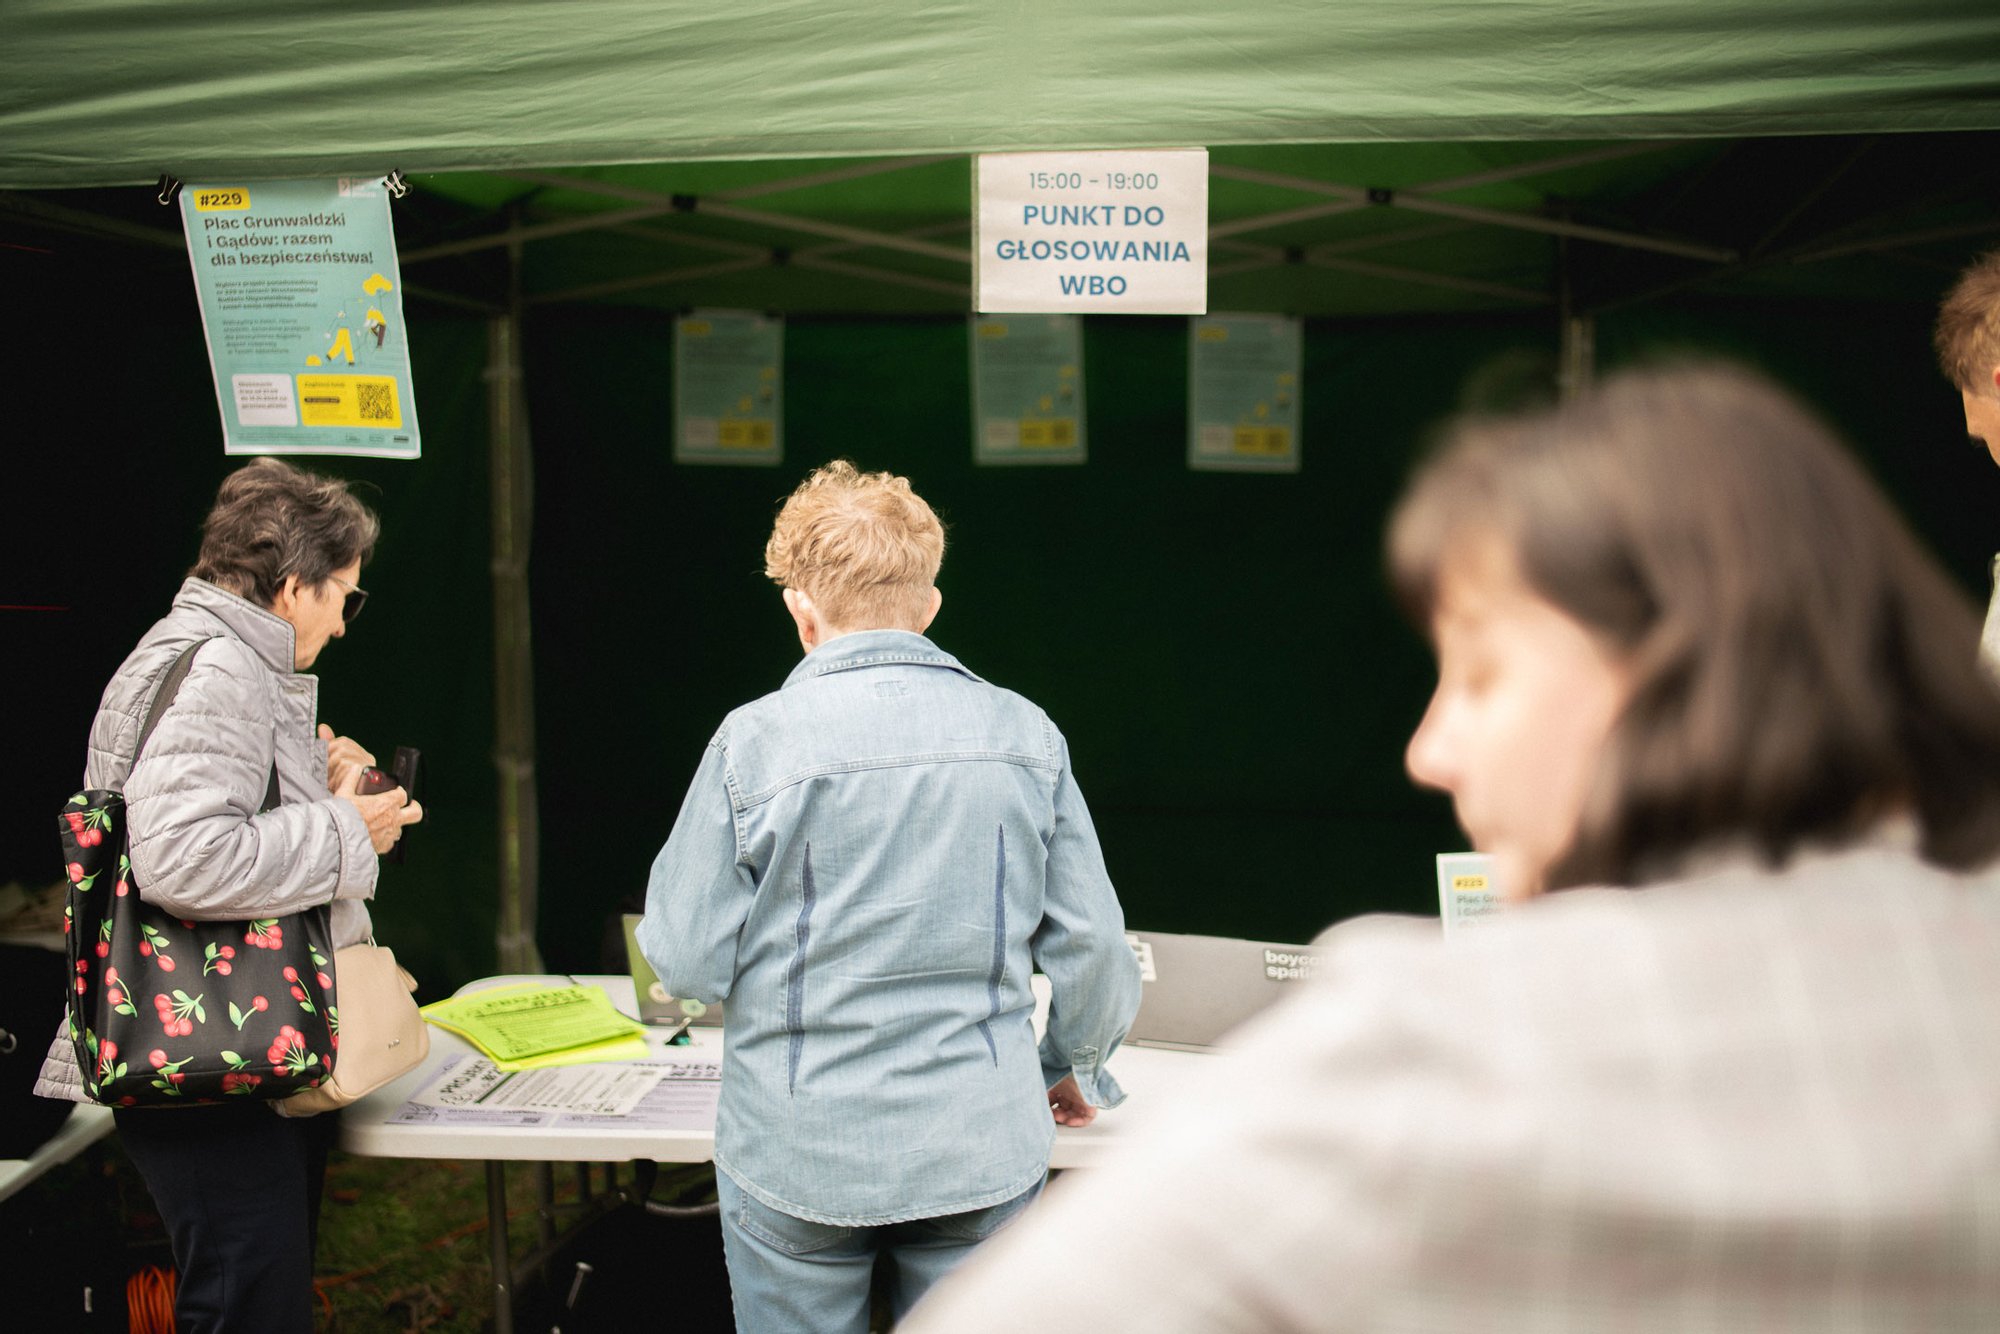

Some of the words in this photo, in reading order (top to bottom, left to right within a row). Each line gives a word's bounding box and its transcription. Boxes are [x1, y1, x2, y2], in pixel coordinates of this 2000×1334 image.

[1029, 172, 1082, 190] 15:00
[1107, 173, 1159, 190] 19:00
[200, 192, 242, 206] #229
[204, 217, 240, 231] Plac
[243, 213, 346, 229] Grunwaldzki
[1023, 205, 1116, 226] PUNKT
[1124, 206, 1164, 226] DO
[207, 236, 213, 248] i
[216, 234, 279, 250] Gądów:
[282, 233, 333, 246] razem
[211, 252, 237, 267] dla
[240, 249, 375, 267] bezpieczeństwa!
[996, 240, 1191, 262] GŁOSOWANIA
[1059, 275, 1127, 296] WBO
[1265, 949, 1322, 967] boyco
[1266, 966, 1311, 980] spati
